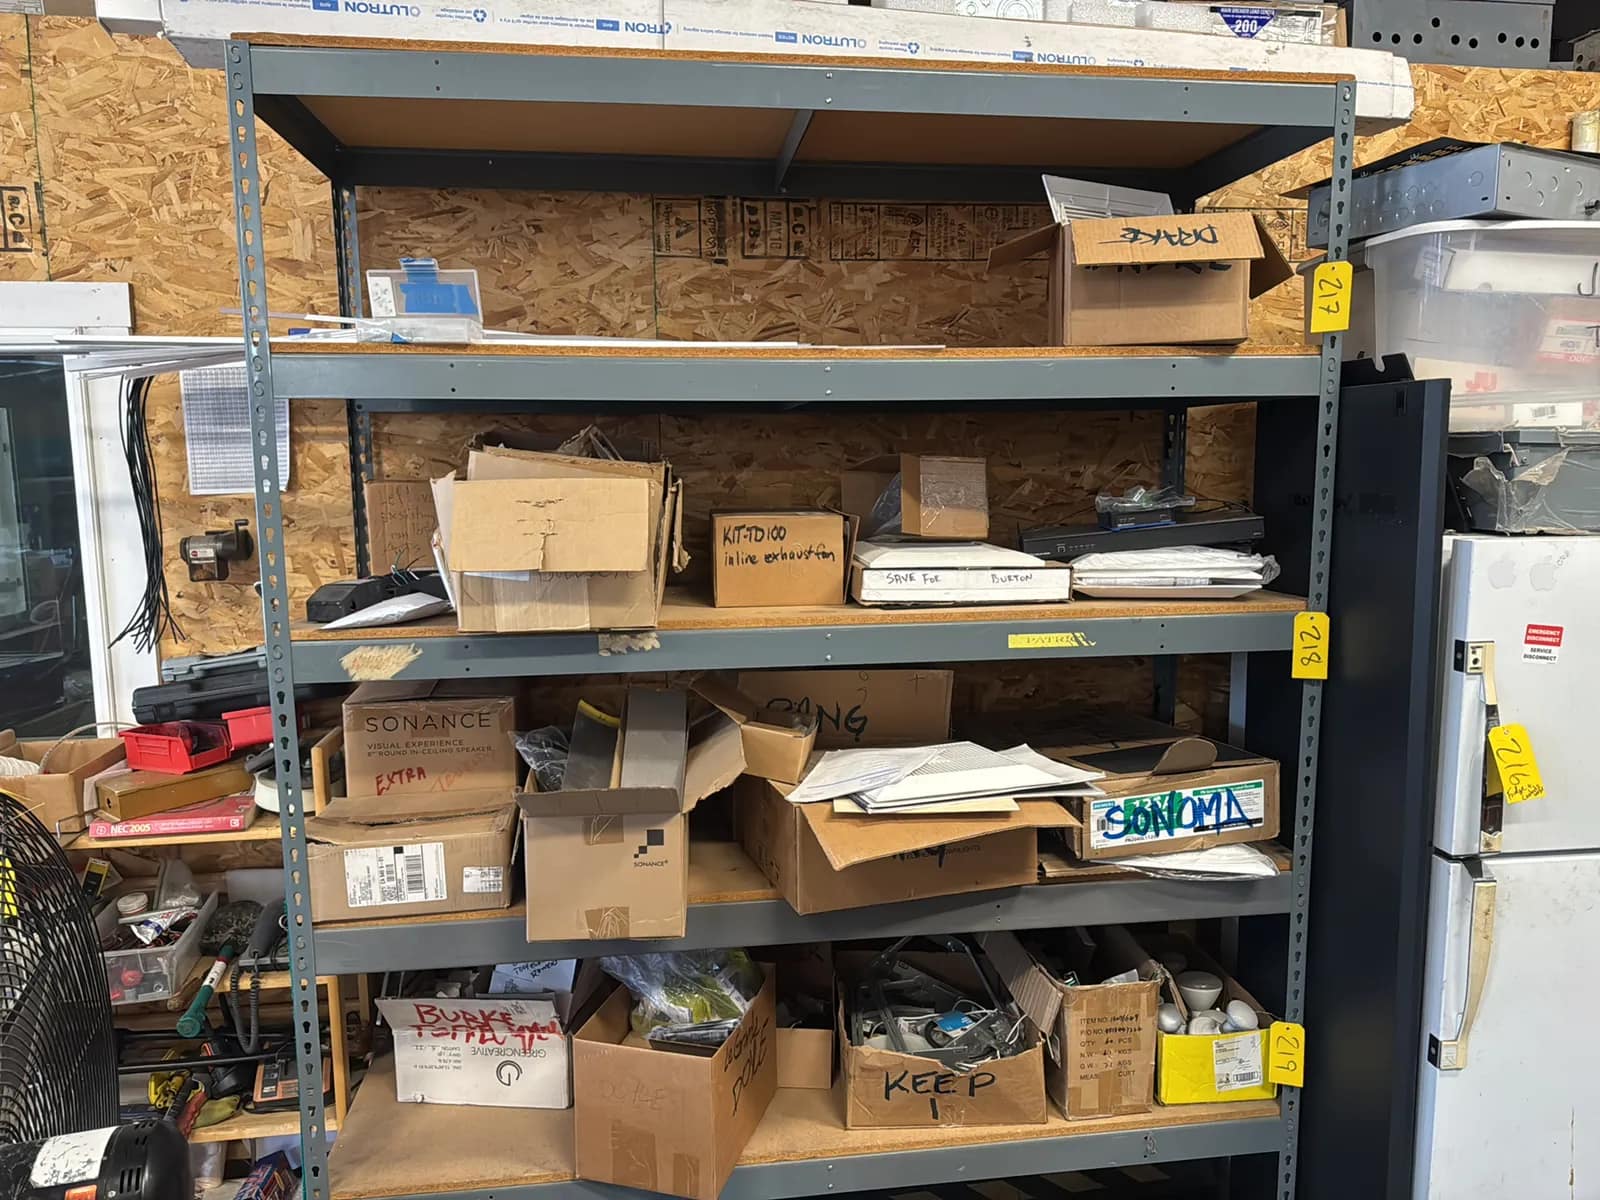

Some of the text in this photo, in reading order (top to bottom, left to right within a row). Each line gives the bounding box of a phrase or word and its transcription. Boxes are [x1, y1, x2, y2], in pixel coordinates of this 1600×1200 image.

[344, 1, 411, 16] LUTRON
[625, 21, 666, 35] TRON
[1234, 19, 1257, 33] 200
[802, 35, 857, 48] LUTRON
[1037, 52, 1088, 64] LUTRON
[1108, 223, 1219, 246] DRAKE
[1317, 276, 1344, 315] 217
[722, 523, 787, 546] KIT-TD100
[723, 550, 759, 566] inline
[885, 572, 917, 585] SAVE
[990, 572, 1034, 584] BURTON
[1299, 625, 1322, 667] 218
[1523, 653, 1557, 661] DISCONNECT
[366, 711, 492, 733] SONANCE
[367, 739, 465, 751] VISUAL EXPERIENCE
[1495, 737, 1531, 786] 216
[375, 766, 427, 796] EXTRA
[1103, 788, 1254, 839] SONOMA
[412, 1002, 515, 1027] BURKE
[1277, 1035, 1299, 1075] 219
[884, 1070, 997, 1100] KEEP
